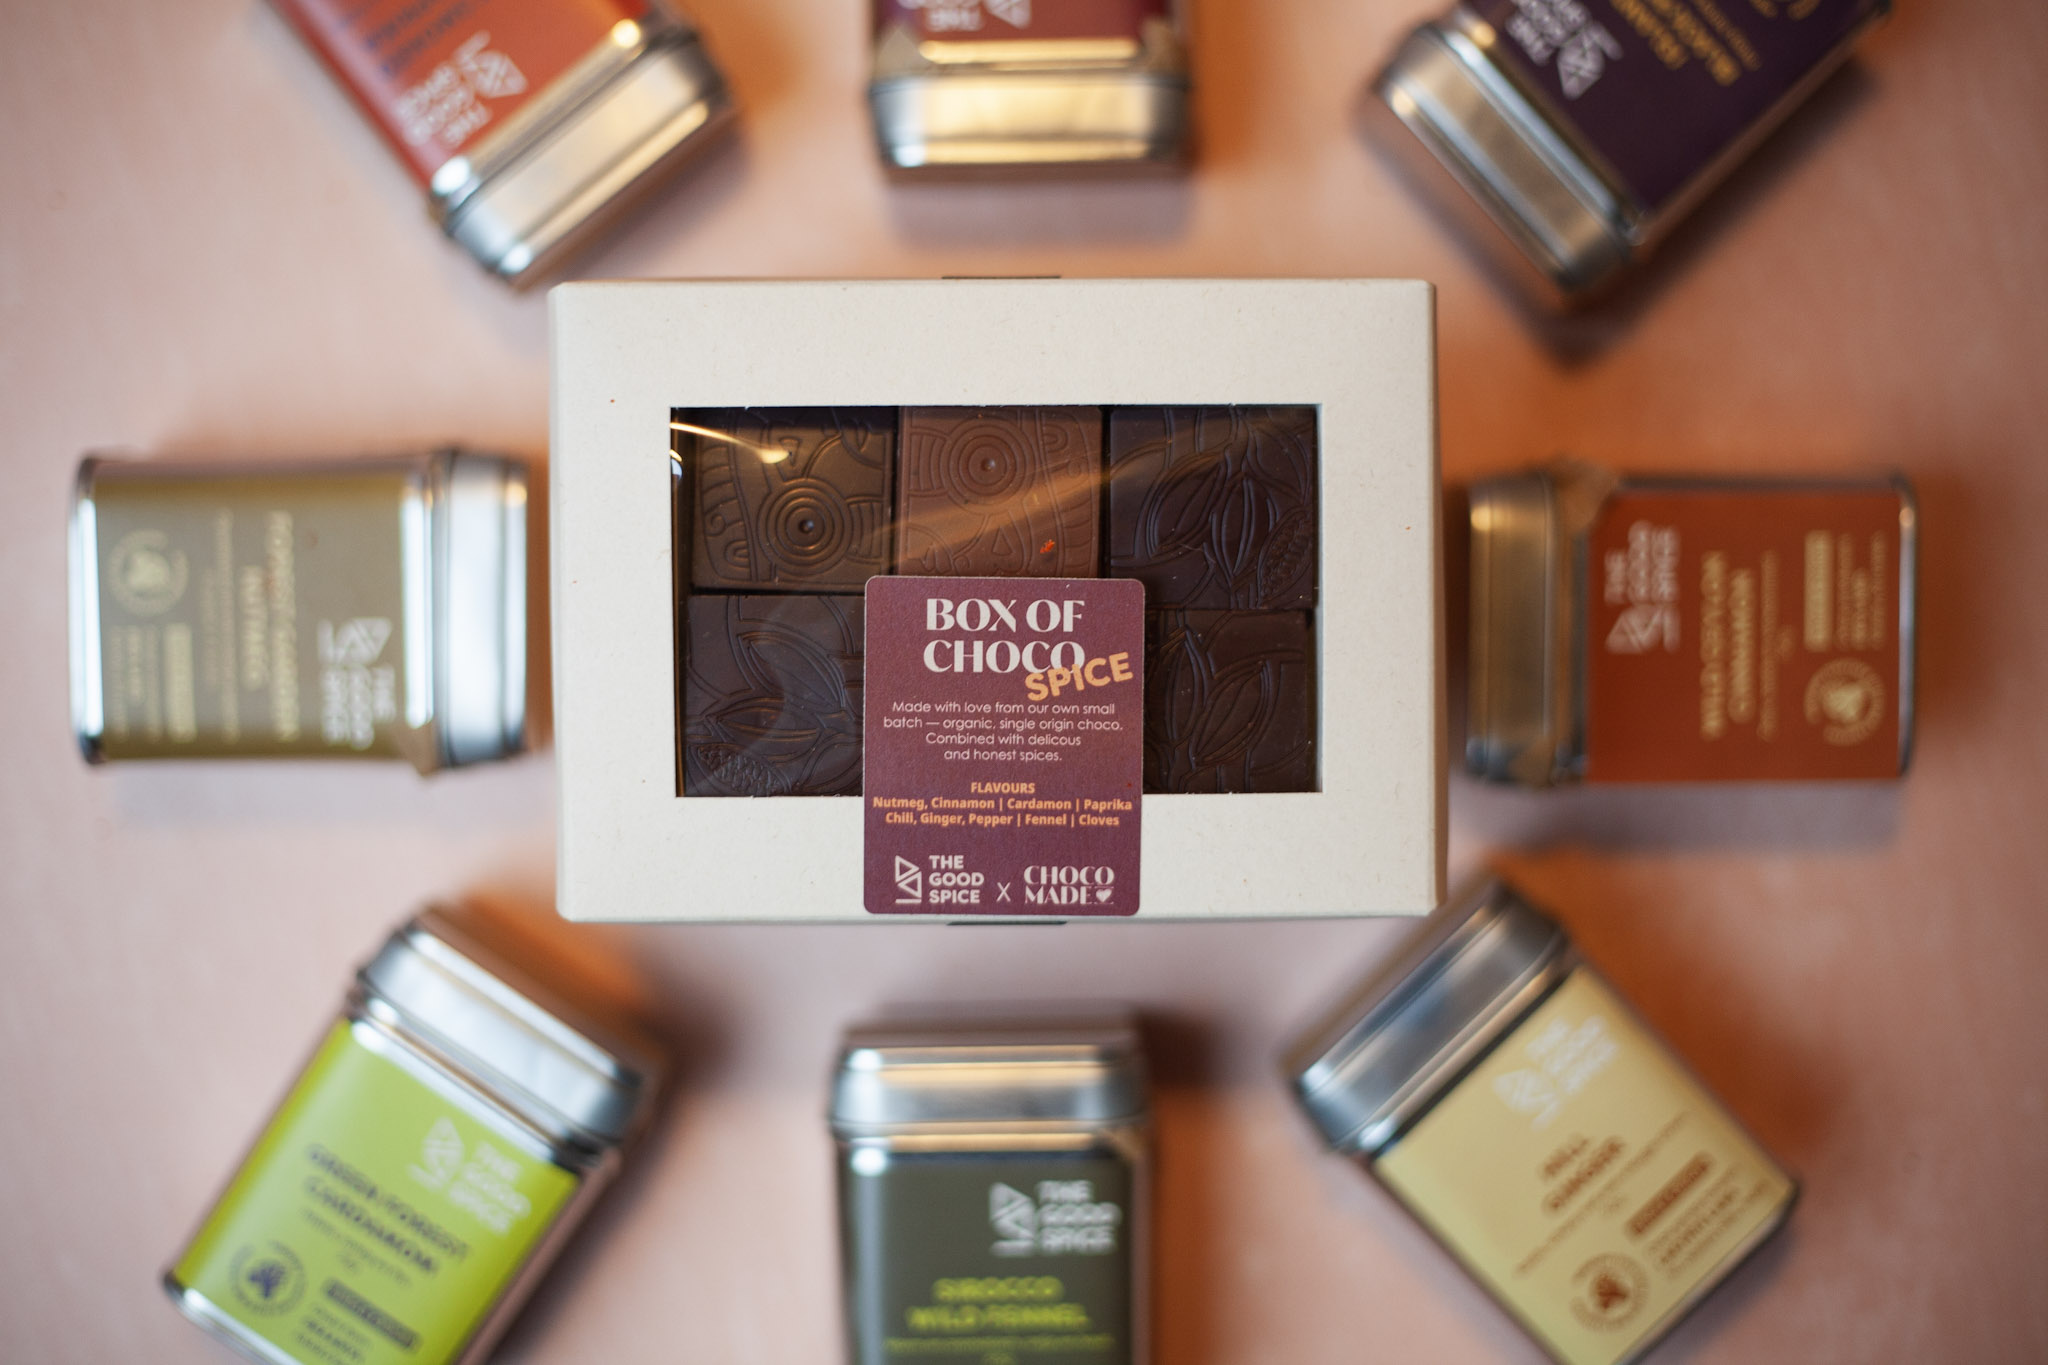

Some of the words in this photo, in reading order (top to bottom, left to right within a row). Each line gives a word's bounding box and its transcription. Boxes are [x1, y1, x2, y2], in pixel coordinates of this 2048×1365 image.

[926, 598, 1017, 633] BOX
[1026, 599, 1085, 633] OF
[923, 640, 1085, 674] CHOCO
[1025, 652, 1134, 702] SPICE
[892, 701, 931, 714] Made
[934, 701, 961, 714] with
[964, 701, 992, 714] love
[995, 702, 1025, 715] from
[1028, 705, 1049, 715] our
[1052, 705, 1080, 715] own
[1083, 703, 1116, 715] small
[884, 716, 923, 729] batch
[999, 717, 1036, 732] single
[1039, 718, 1075, 732] origin
[1077, 718, 1123, 732] choco.
[925, 732, 995, 745] Combined
[998, 732, 1024, 746] with
[1028, 733, 1081, 746] delicous
[944, 748, 970, 760] and
[973, 748, 1016, 761] honest
[1020, 749, 1062, 764] spices.
[970, 782, 1036, 795] FLAVOURS
[873, 797, 929, 811] Nutmeg,
[931, 797, 996, 809] Cinnamon
[1007, 798, 1072, 811] Cardamon
[1083, 799, 1132, 813] Paprika
[885, 812, 917, 826] Chili,
[920, 812, 966, 827] Ginger,
[969, 813, 1013, 827] Pepper
[1025, 813, 1067, 825] Fennel
[1079, 814, 1120, 827] Cloves
[929, 855, 965, 870] THE
[928, 871, 985, 888] GOOD
[1023, 865, 1115, 886] CHOCO
[928, 888, 981, 905] SPICE
[1025, 886, 1092, 905] MADE
